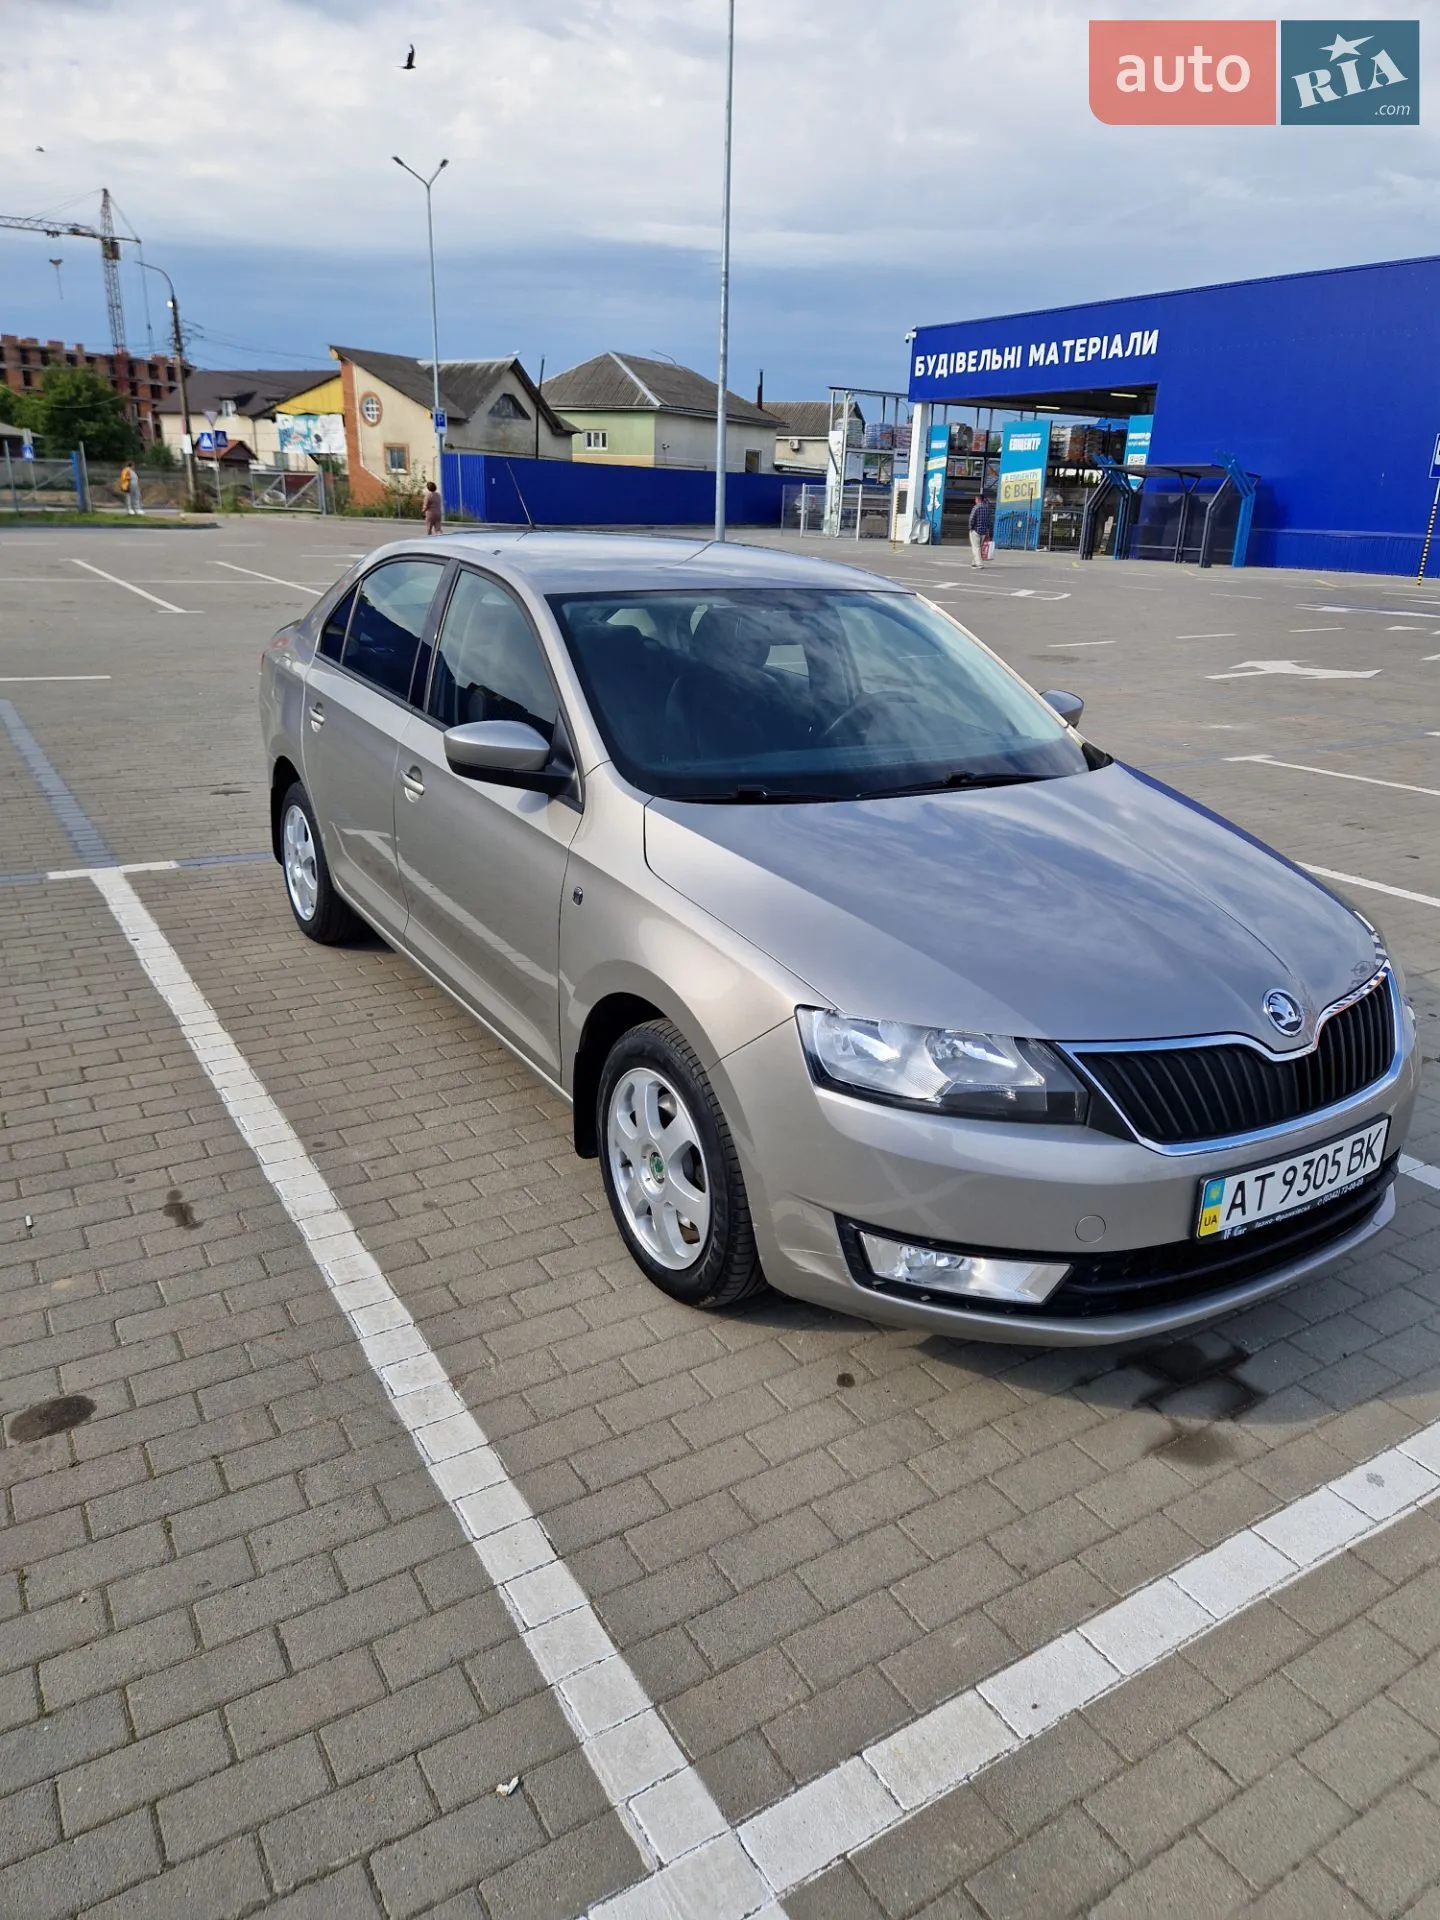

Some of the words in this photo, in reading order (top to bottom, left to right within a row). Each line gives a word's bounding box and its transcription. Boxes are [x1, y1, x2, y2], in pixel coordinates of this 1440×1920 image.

[914, 345, 1022, 378] БУДІВЕЛЬНІ
[1028, 329, 1159, 367] МАТЕРІАЛИ
[1225, 1170, 1275, 1221] AT
[1280, 1146, 1343, 1204] 9305
[1347, 1128, 1383, 1177] BK
[1204, 1214, 1217, 1227] UA
